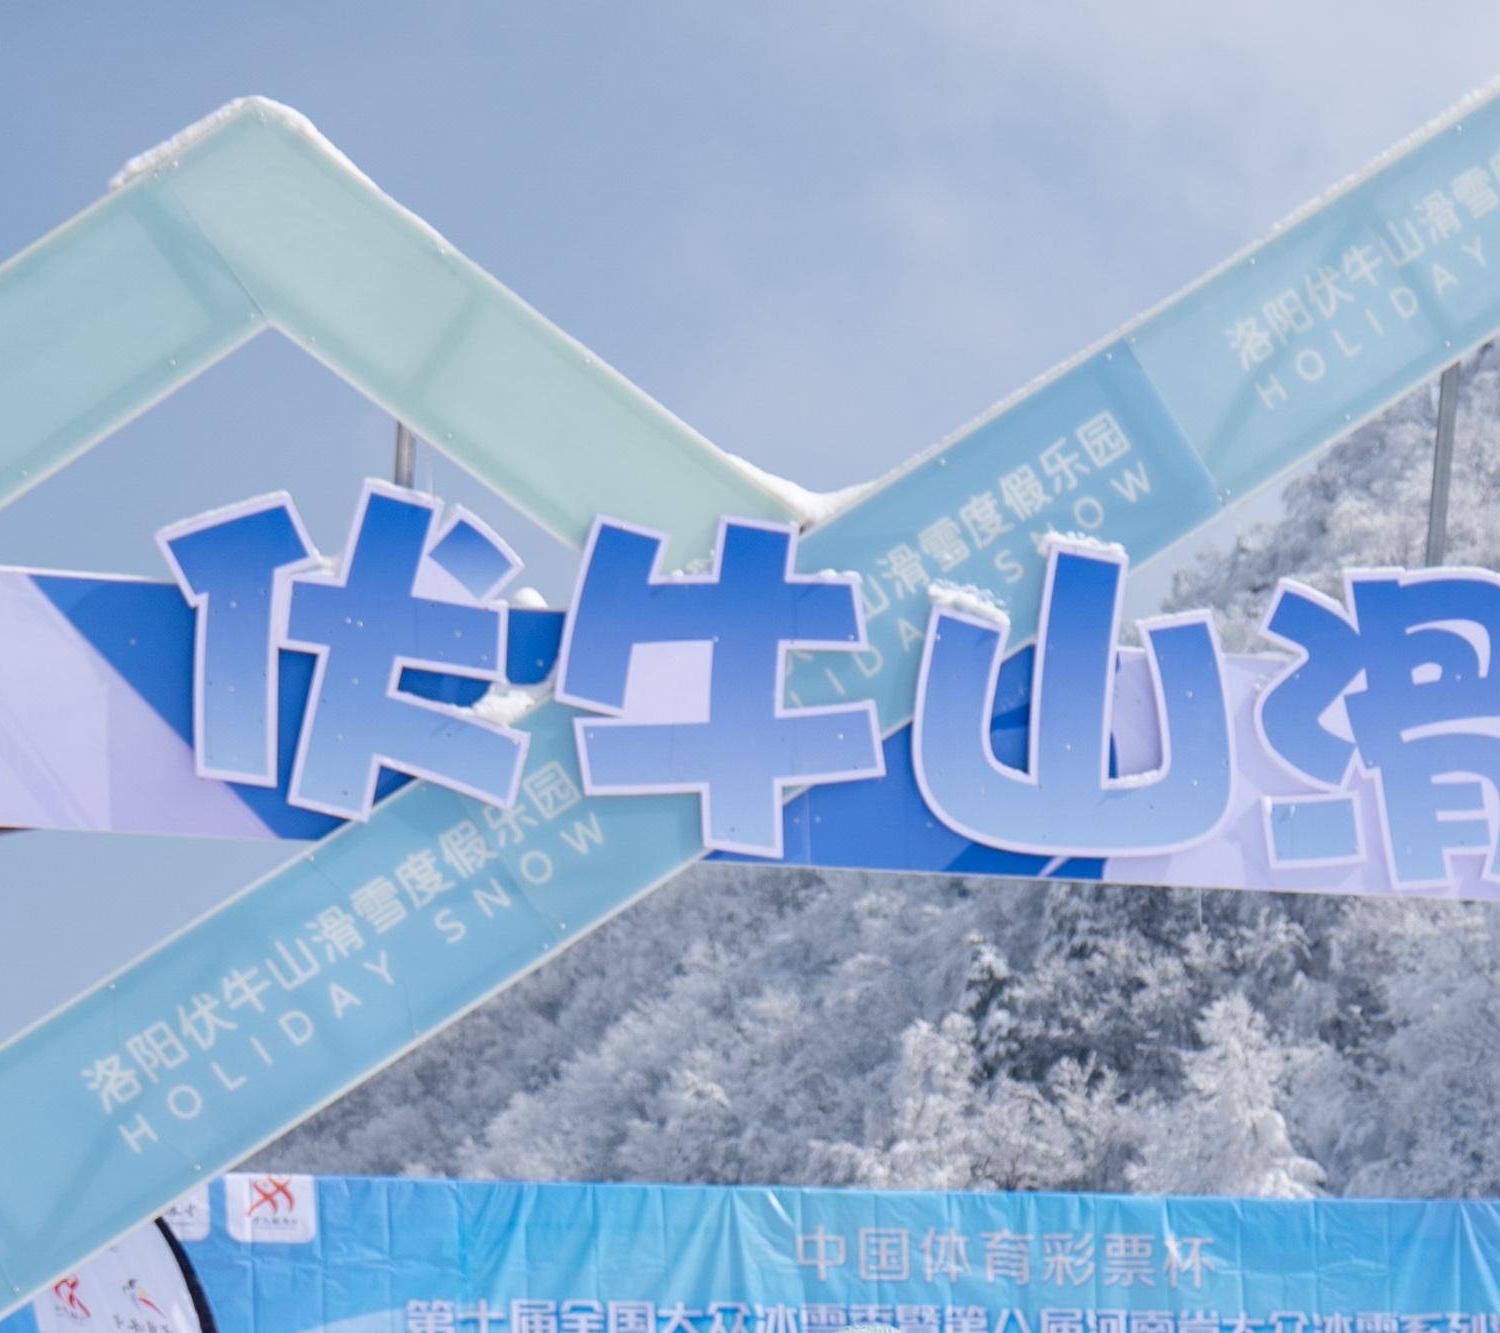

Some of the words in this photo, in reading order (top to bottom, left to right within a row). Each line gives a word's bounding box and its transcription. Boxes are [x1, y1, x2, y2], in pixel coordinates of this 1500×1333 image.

[1255, 235, 1488, 410] HOLIDAY
[993, 460, 1153, 584] SOW
[80, 760, 582, 1112] 洛阳伏牛山滑雪度假乐园
[118, 951, 396, 1152] HOLIDAY
[434, 812, 606, 944] SNOW
[796, 1225, 1218, 1288] 中国体育彩票杯
